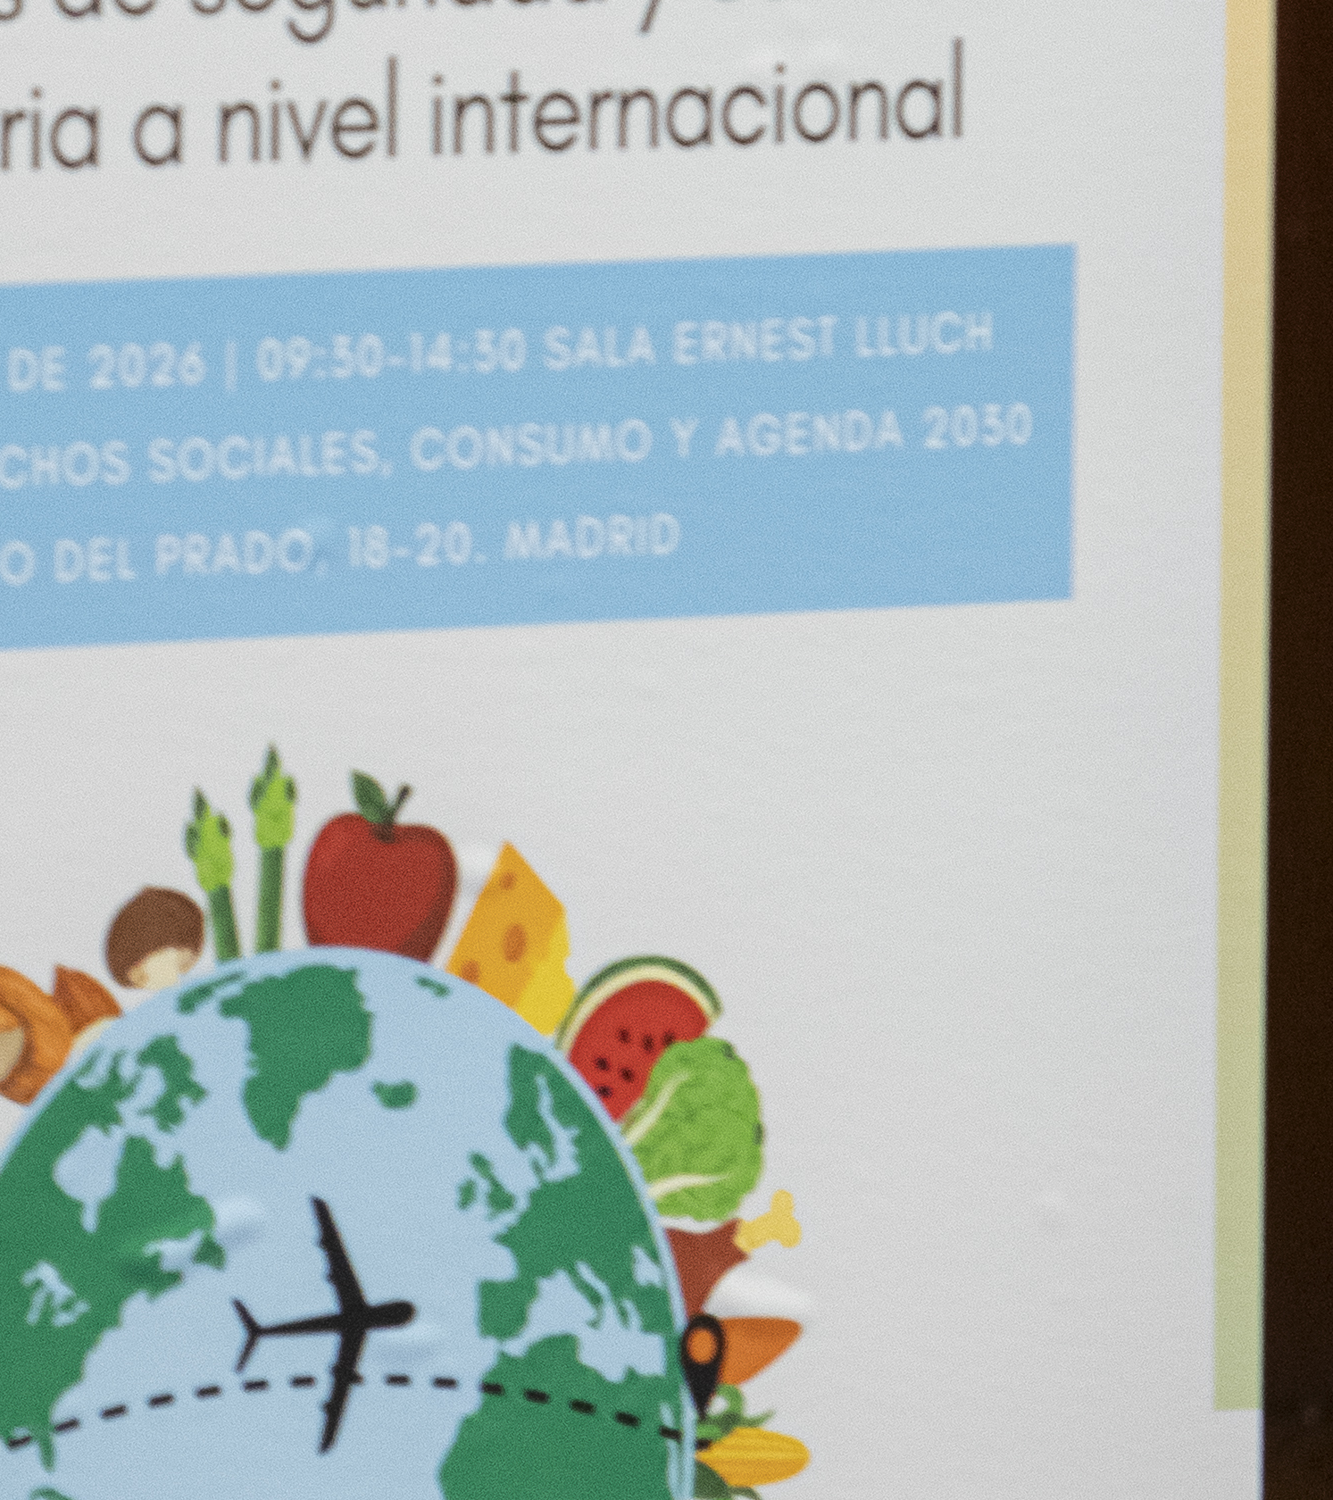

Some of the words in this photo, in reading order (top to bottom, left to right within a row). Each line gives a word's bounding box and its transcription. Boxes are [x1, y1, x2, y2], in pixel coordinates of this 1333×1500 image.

[130, 101, 186, 171] a
[216, 54, 400, 165] nivel
[430, 37, 966, 157] internacional
[5, 342, 68, 396] DE
[85, 338, 210, 393] 2026
[540, 321, 659, 374] SALA
[669, 312, 840, 369] ERNEST
[852, 307, 996, 361] LLUCH
[145, 426, 395, 486] SOCIALES,
[407, 415, 656, 475] CONSUMO
[668, 414, 702, 462] Y
[712, 405, 907, 460] AGENDA
[51, 534, 138, 587] DEL
[501, 509, 684, 562] MADRID
